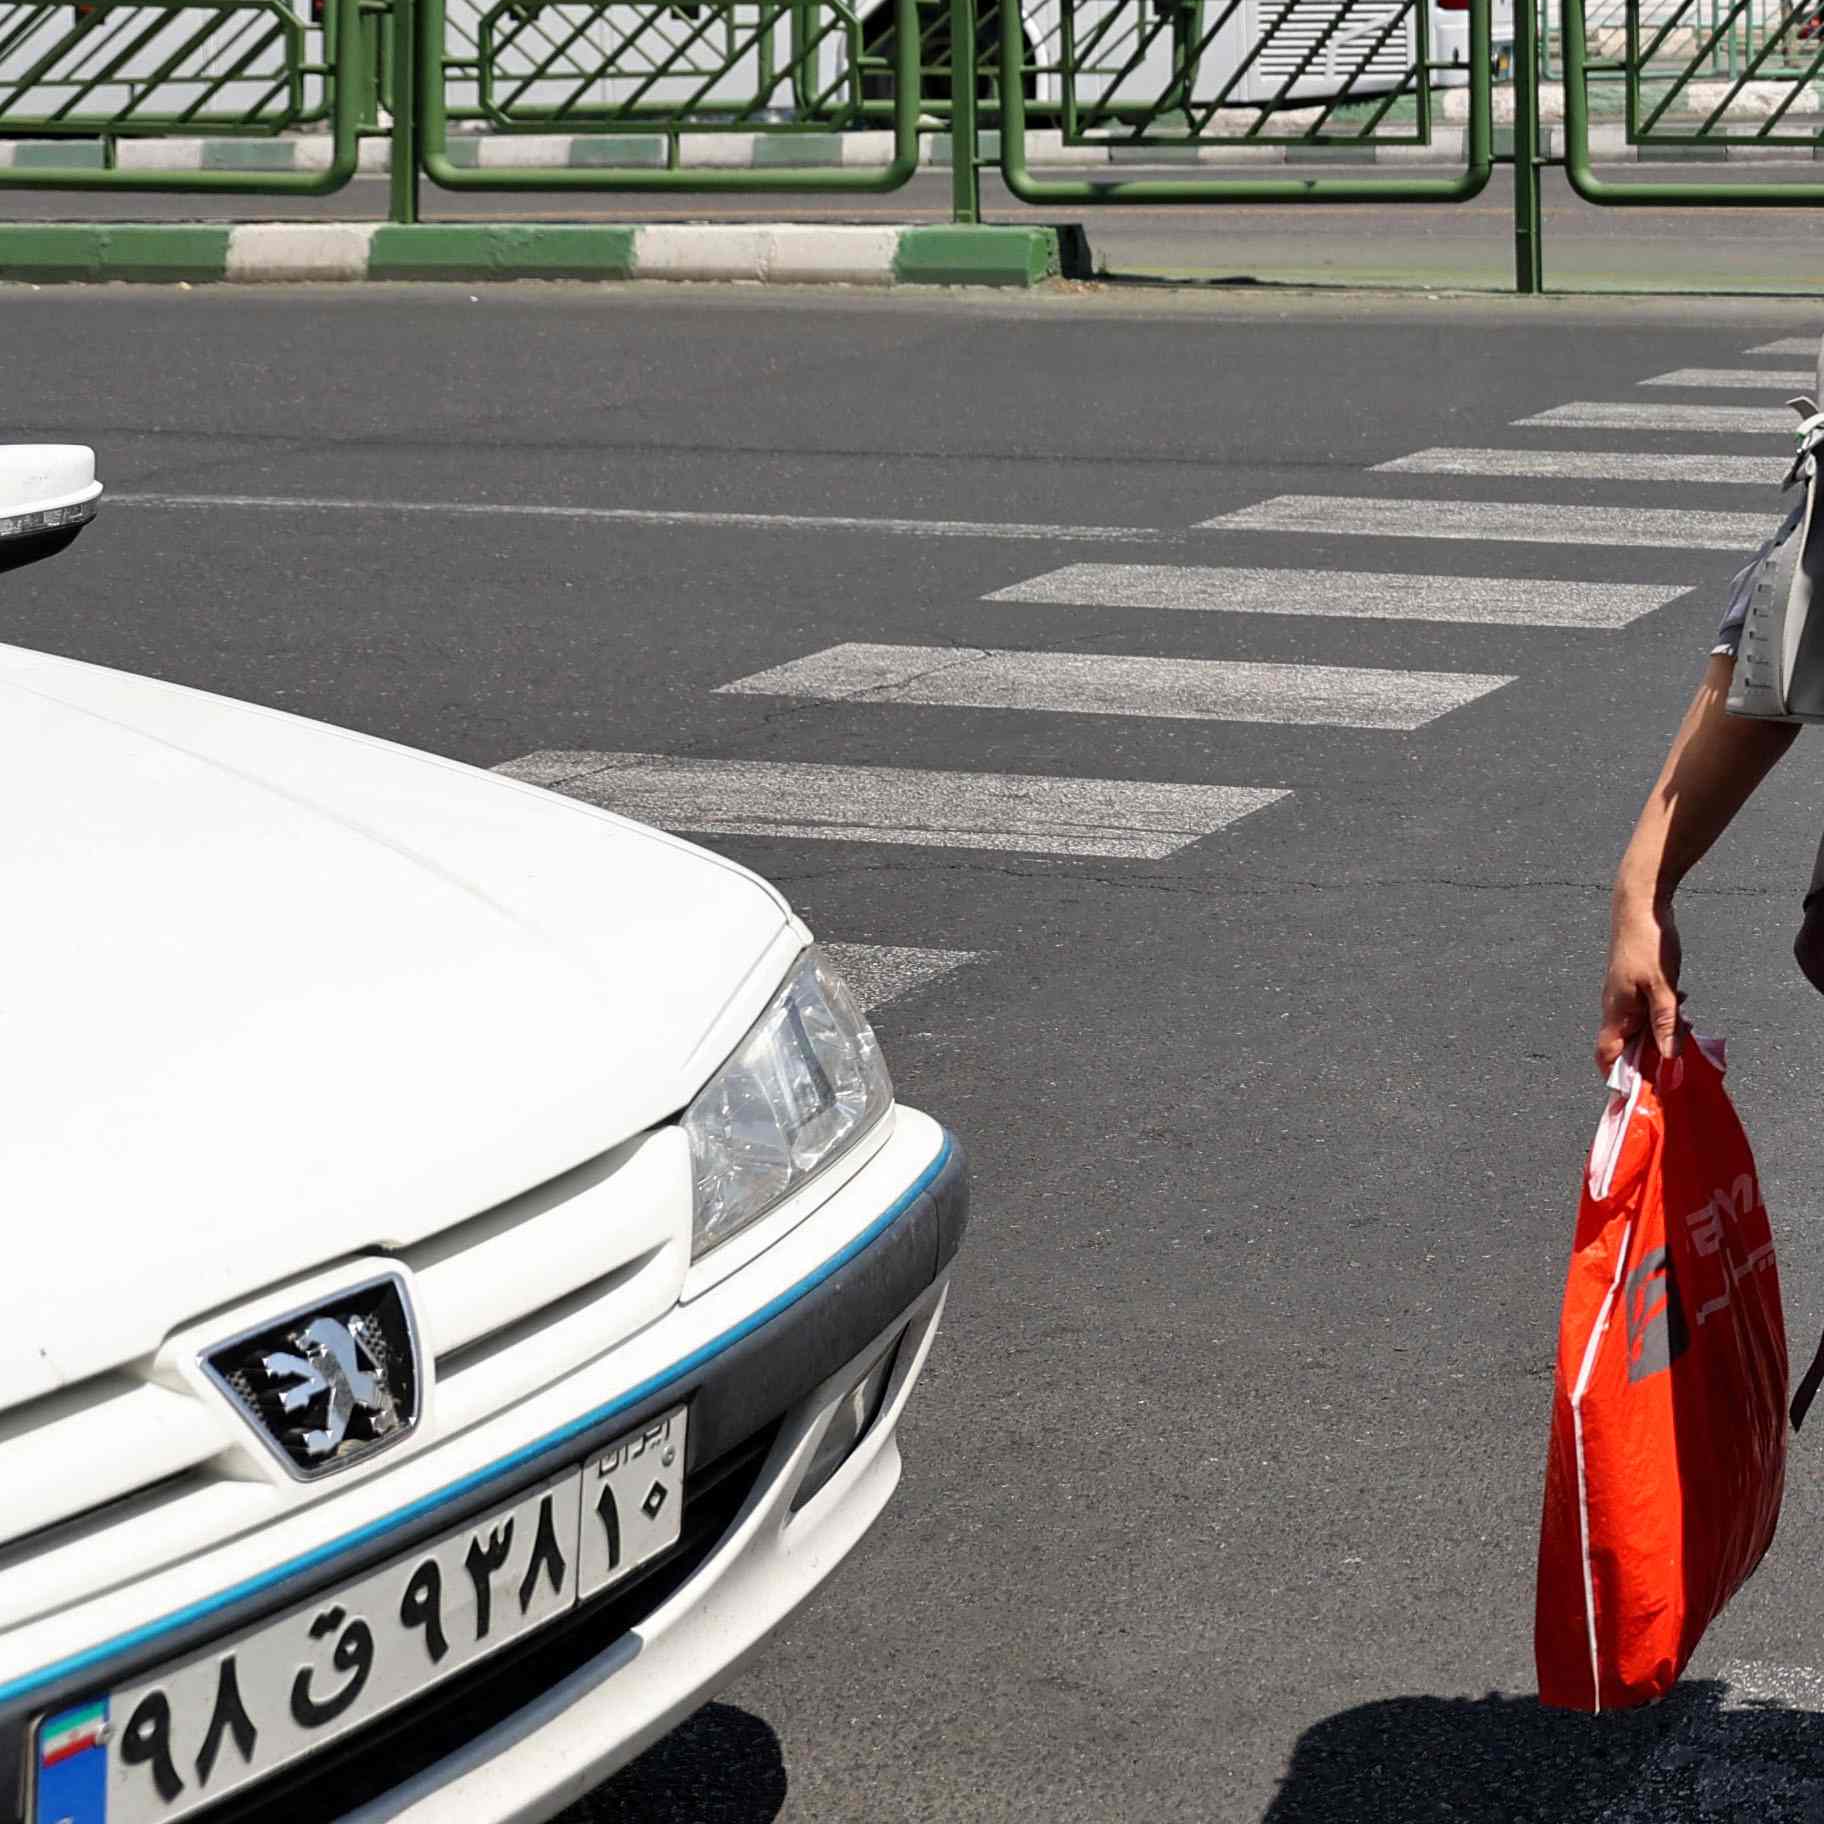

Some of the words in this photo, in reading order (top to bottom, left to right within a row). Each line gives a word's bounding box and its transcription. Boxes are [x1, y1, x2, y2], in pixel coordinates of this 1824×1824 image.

[597, 1418, 672, 1481] ایران
[120, 1654, 260, 1803] ۹۸
[290, 1606, 375, 1729] ق
